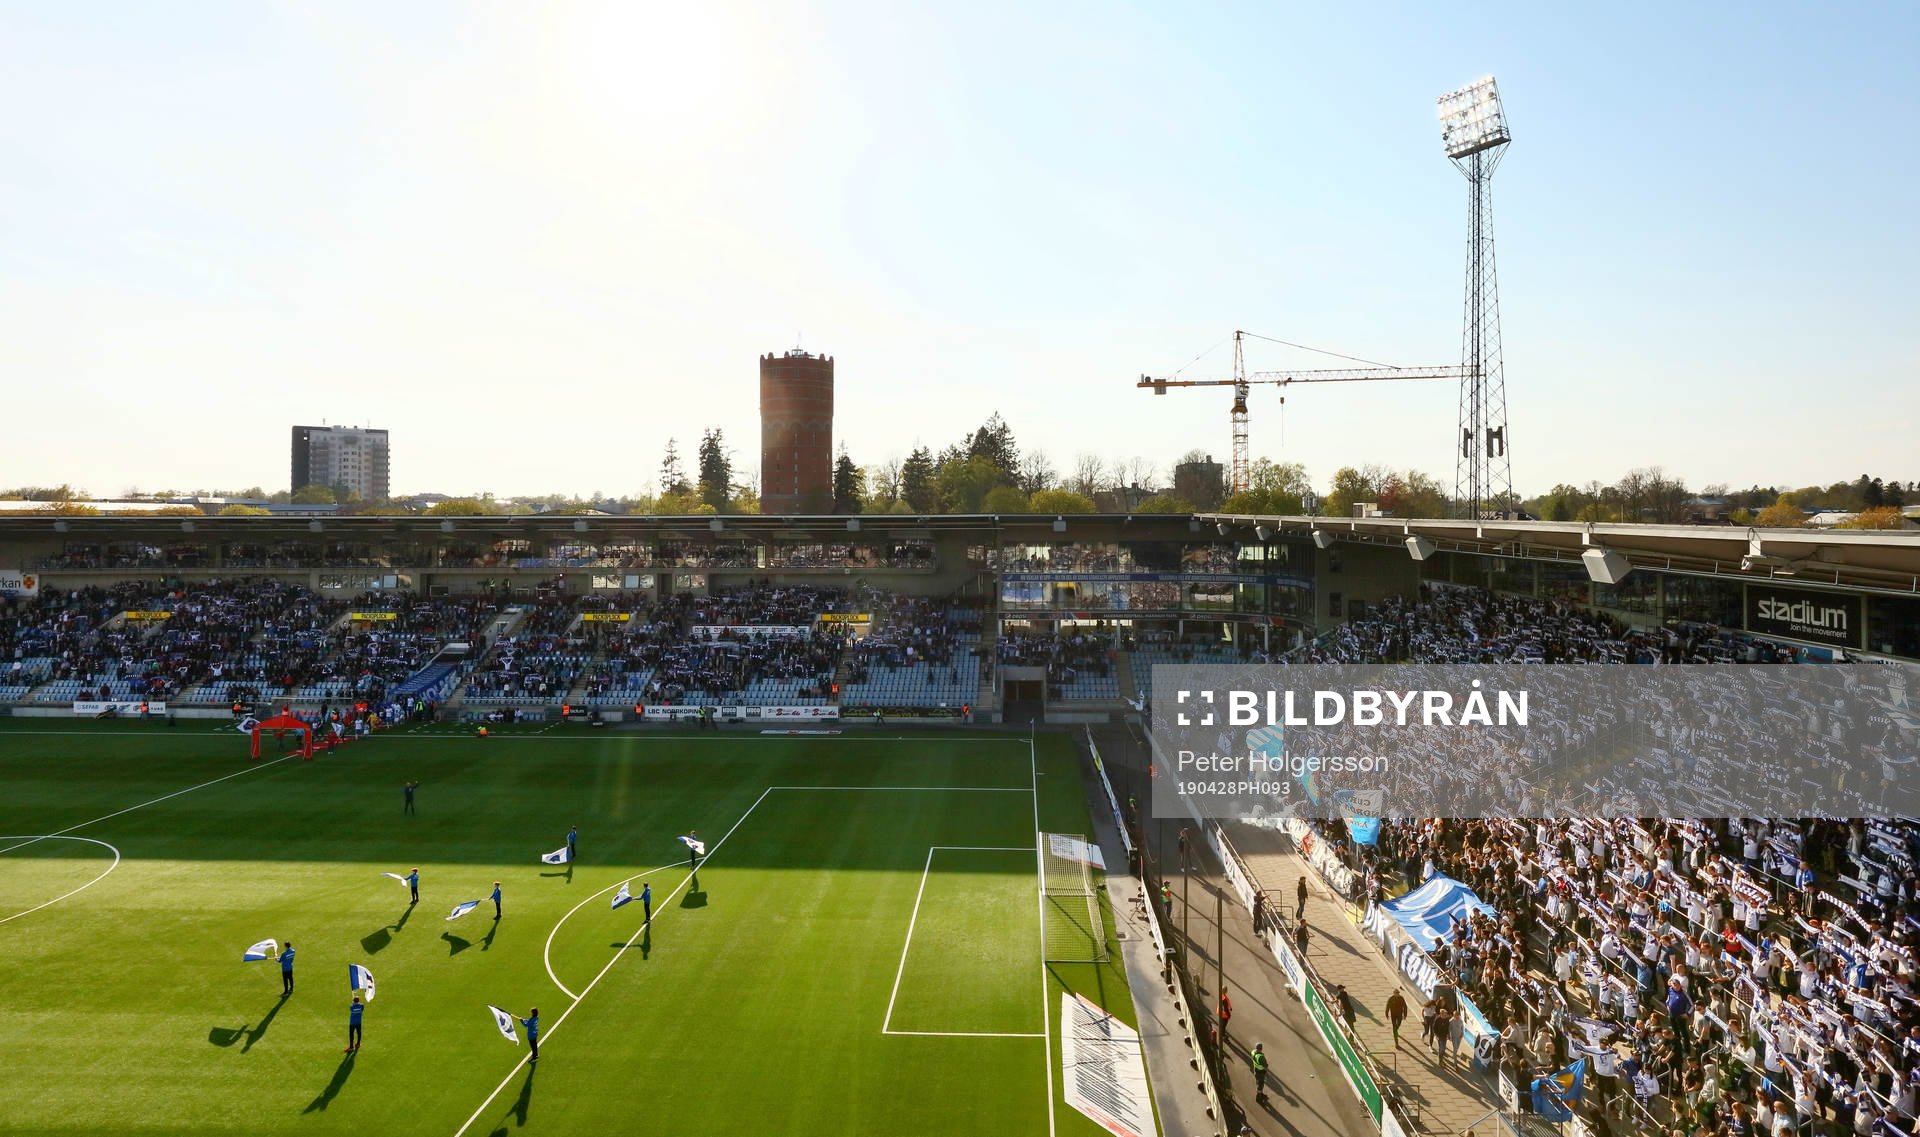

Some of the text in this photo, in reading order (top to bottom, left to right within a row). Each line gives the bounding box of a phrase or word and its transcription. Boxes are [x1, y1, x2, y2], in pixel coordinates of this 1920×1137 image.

[1758, 596, 1847, 629] stadium
[1790, 623, 1847, 638] Join the movement
